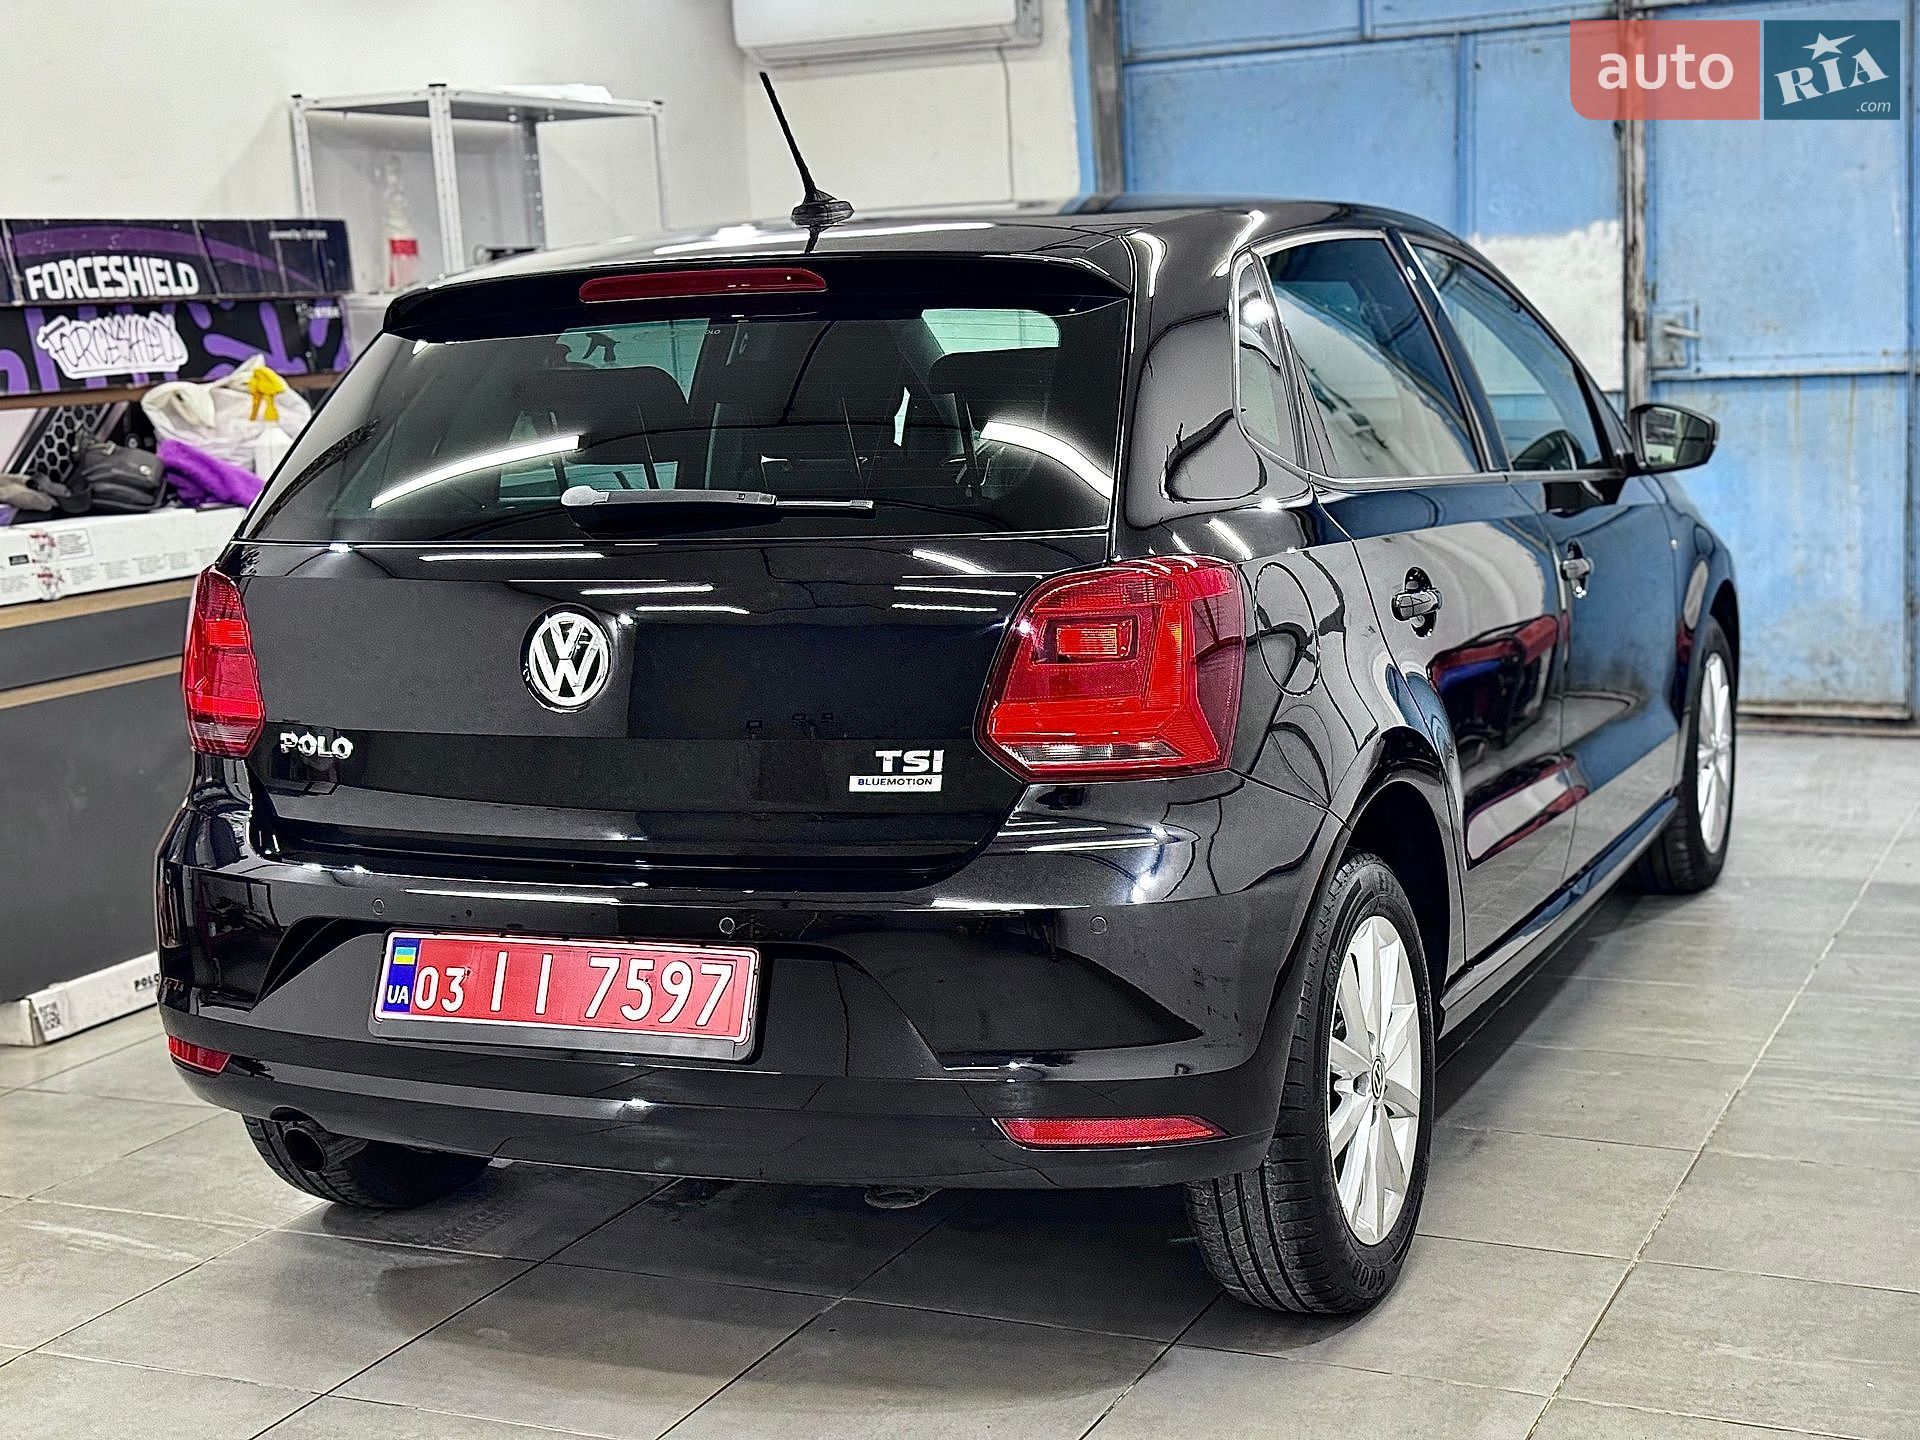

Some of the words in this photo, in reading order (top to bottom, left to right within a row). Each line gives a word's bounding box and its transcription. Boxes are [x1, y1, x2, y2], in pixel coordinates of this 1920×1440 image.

[25, 255, 199, 300] FORCESHIELD
[280, 731, 354, 759] POLO
[875, 750, 944, 773] TSI
[858, 778, 933, 786] BLUEMOTION
[386, 984, 409, 1005] UA
[415, 966, 466, 1012] 03
[584, 956, 733, 1027] 7597
